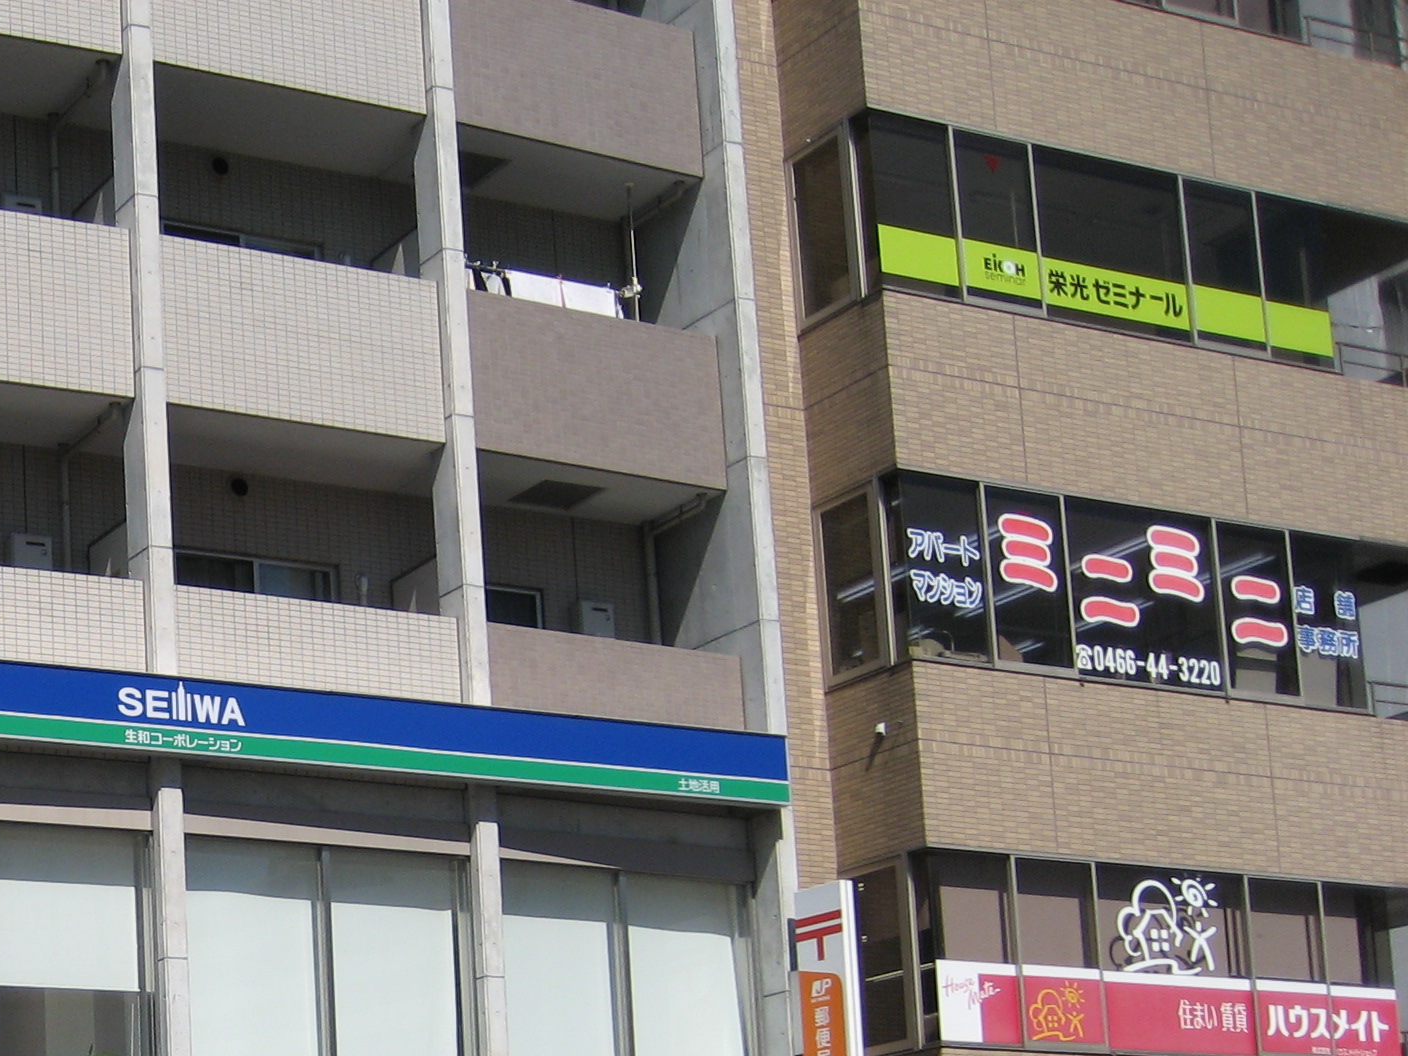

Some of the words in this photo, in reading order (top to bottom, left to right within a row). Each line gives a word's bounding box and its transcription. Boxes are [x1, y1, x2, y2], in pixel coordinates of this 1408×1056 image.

[1047, 269, 1183, 317] 栄光ゼミナール
[907, 528, 980, 567] アパート
[910, 569, 982, 608] マンション
[1295, 624, 1359, 659] 事務所
[1093, 645, 1221, 686] 0466-44-3220
[124, 729, 242, 752] 生和コーポレーション
[678, 777, 720, 794] 土地活用
[1267, 1004, 1390, 1042] ハウスメイト
